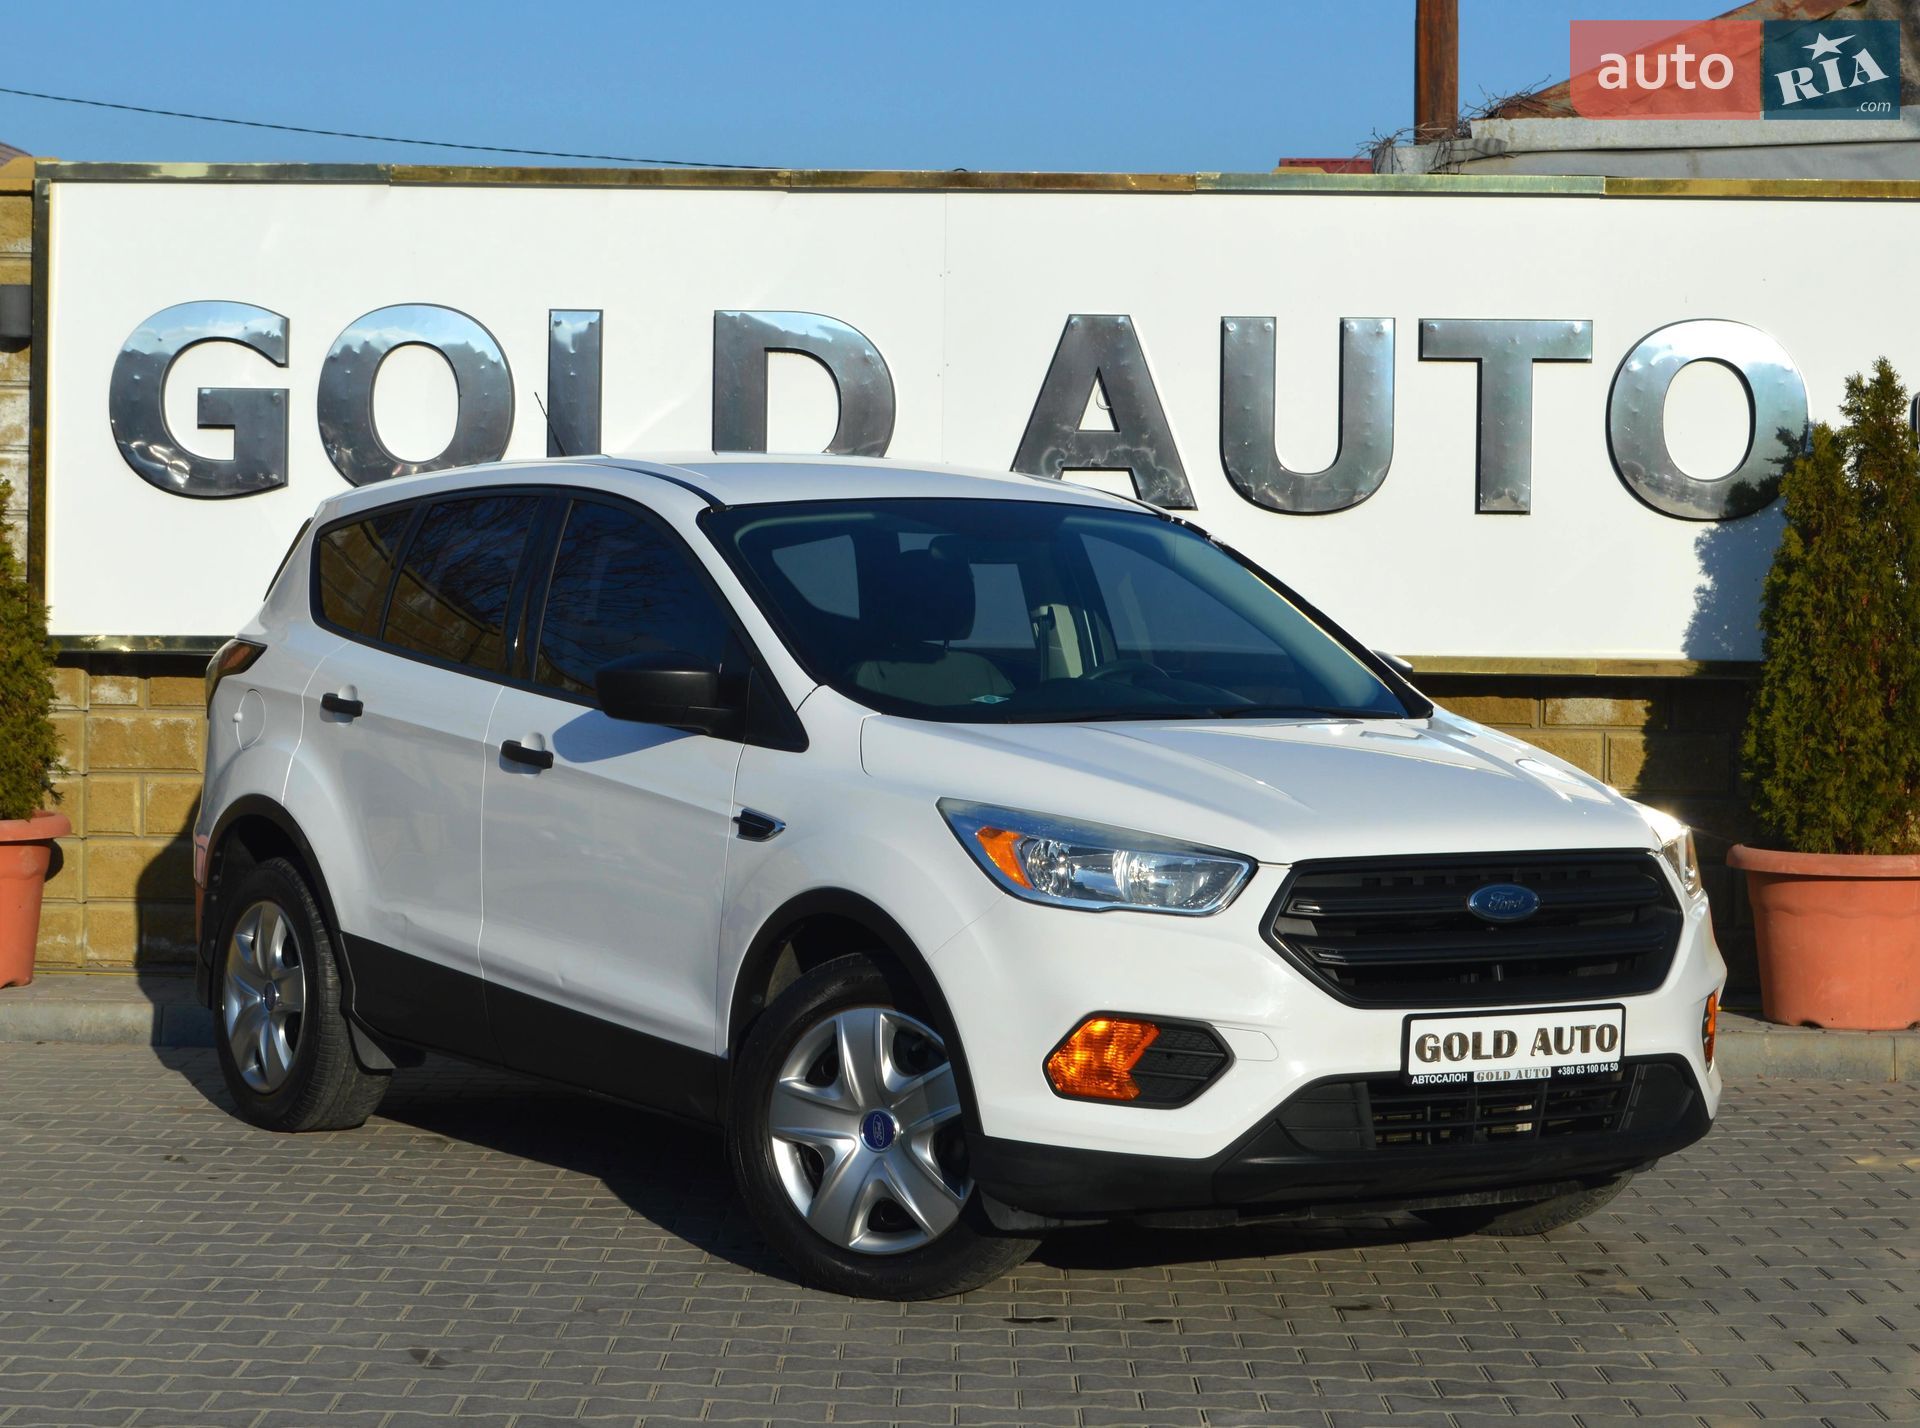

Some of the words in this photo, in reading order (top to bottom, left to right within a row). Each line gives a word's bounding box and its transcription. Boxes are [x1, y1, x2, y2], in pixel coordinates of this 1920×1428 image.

[1011, 312, 1809, 522] AUTO
[1488, 890, 1525, 910] Ford
[1414, 1029, 1519, 1063] GOLD
[1530, 1023, 1619, 1057] AUTO
[1476, 1070, 1511, 1082] GOLD
[1515, 1067, 1550, 1080] AUTO
[1557, 1066, 1575, 1076] +380
[1576, 1065, 1585, 1074] 63
[1586, 1064, 1599, 1074] 100
[1599, 1063, 1609, 1072] 04
[1609, 1062, 1619, 1072] 50
[1411, 1072, 1468, 1085] АВТОСАЛОН
